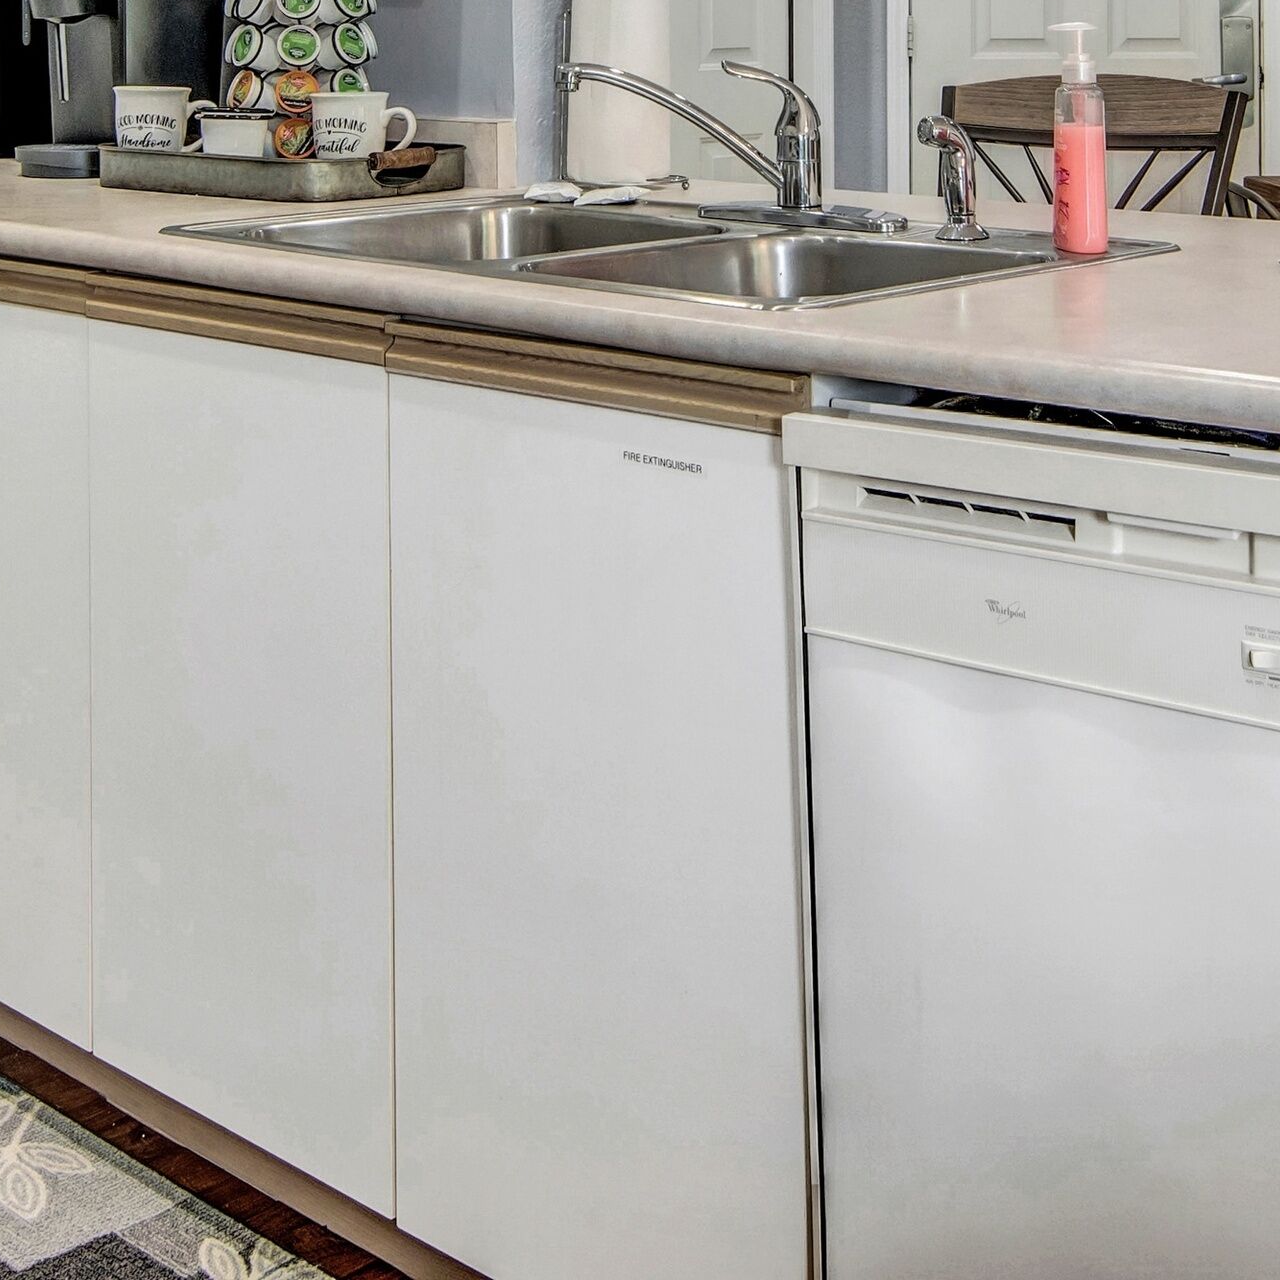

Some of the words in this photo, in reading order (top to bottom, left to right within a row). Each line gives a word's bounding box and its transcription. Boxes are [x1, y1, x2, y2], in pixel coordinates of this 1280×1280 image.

[136, 113, 177, 130] MORNING
[325, 117, 368, 133] MORNING
[120, 131, 172, 148] Handsome
[623, 450, 641, 463] FIRE
[642, 454, 703, 474] EXTINGUISHER
[985, 599, 1026, 620] Whirlpool
